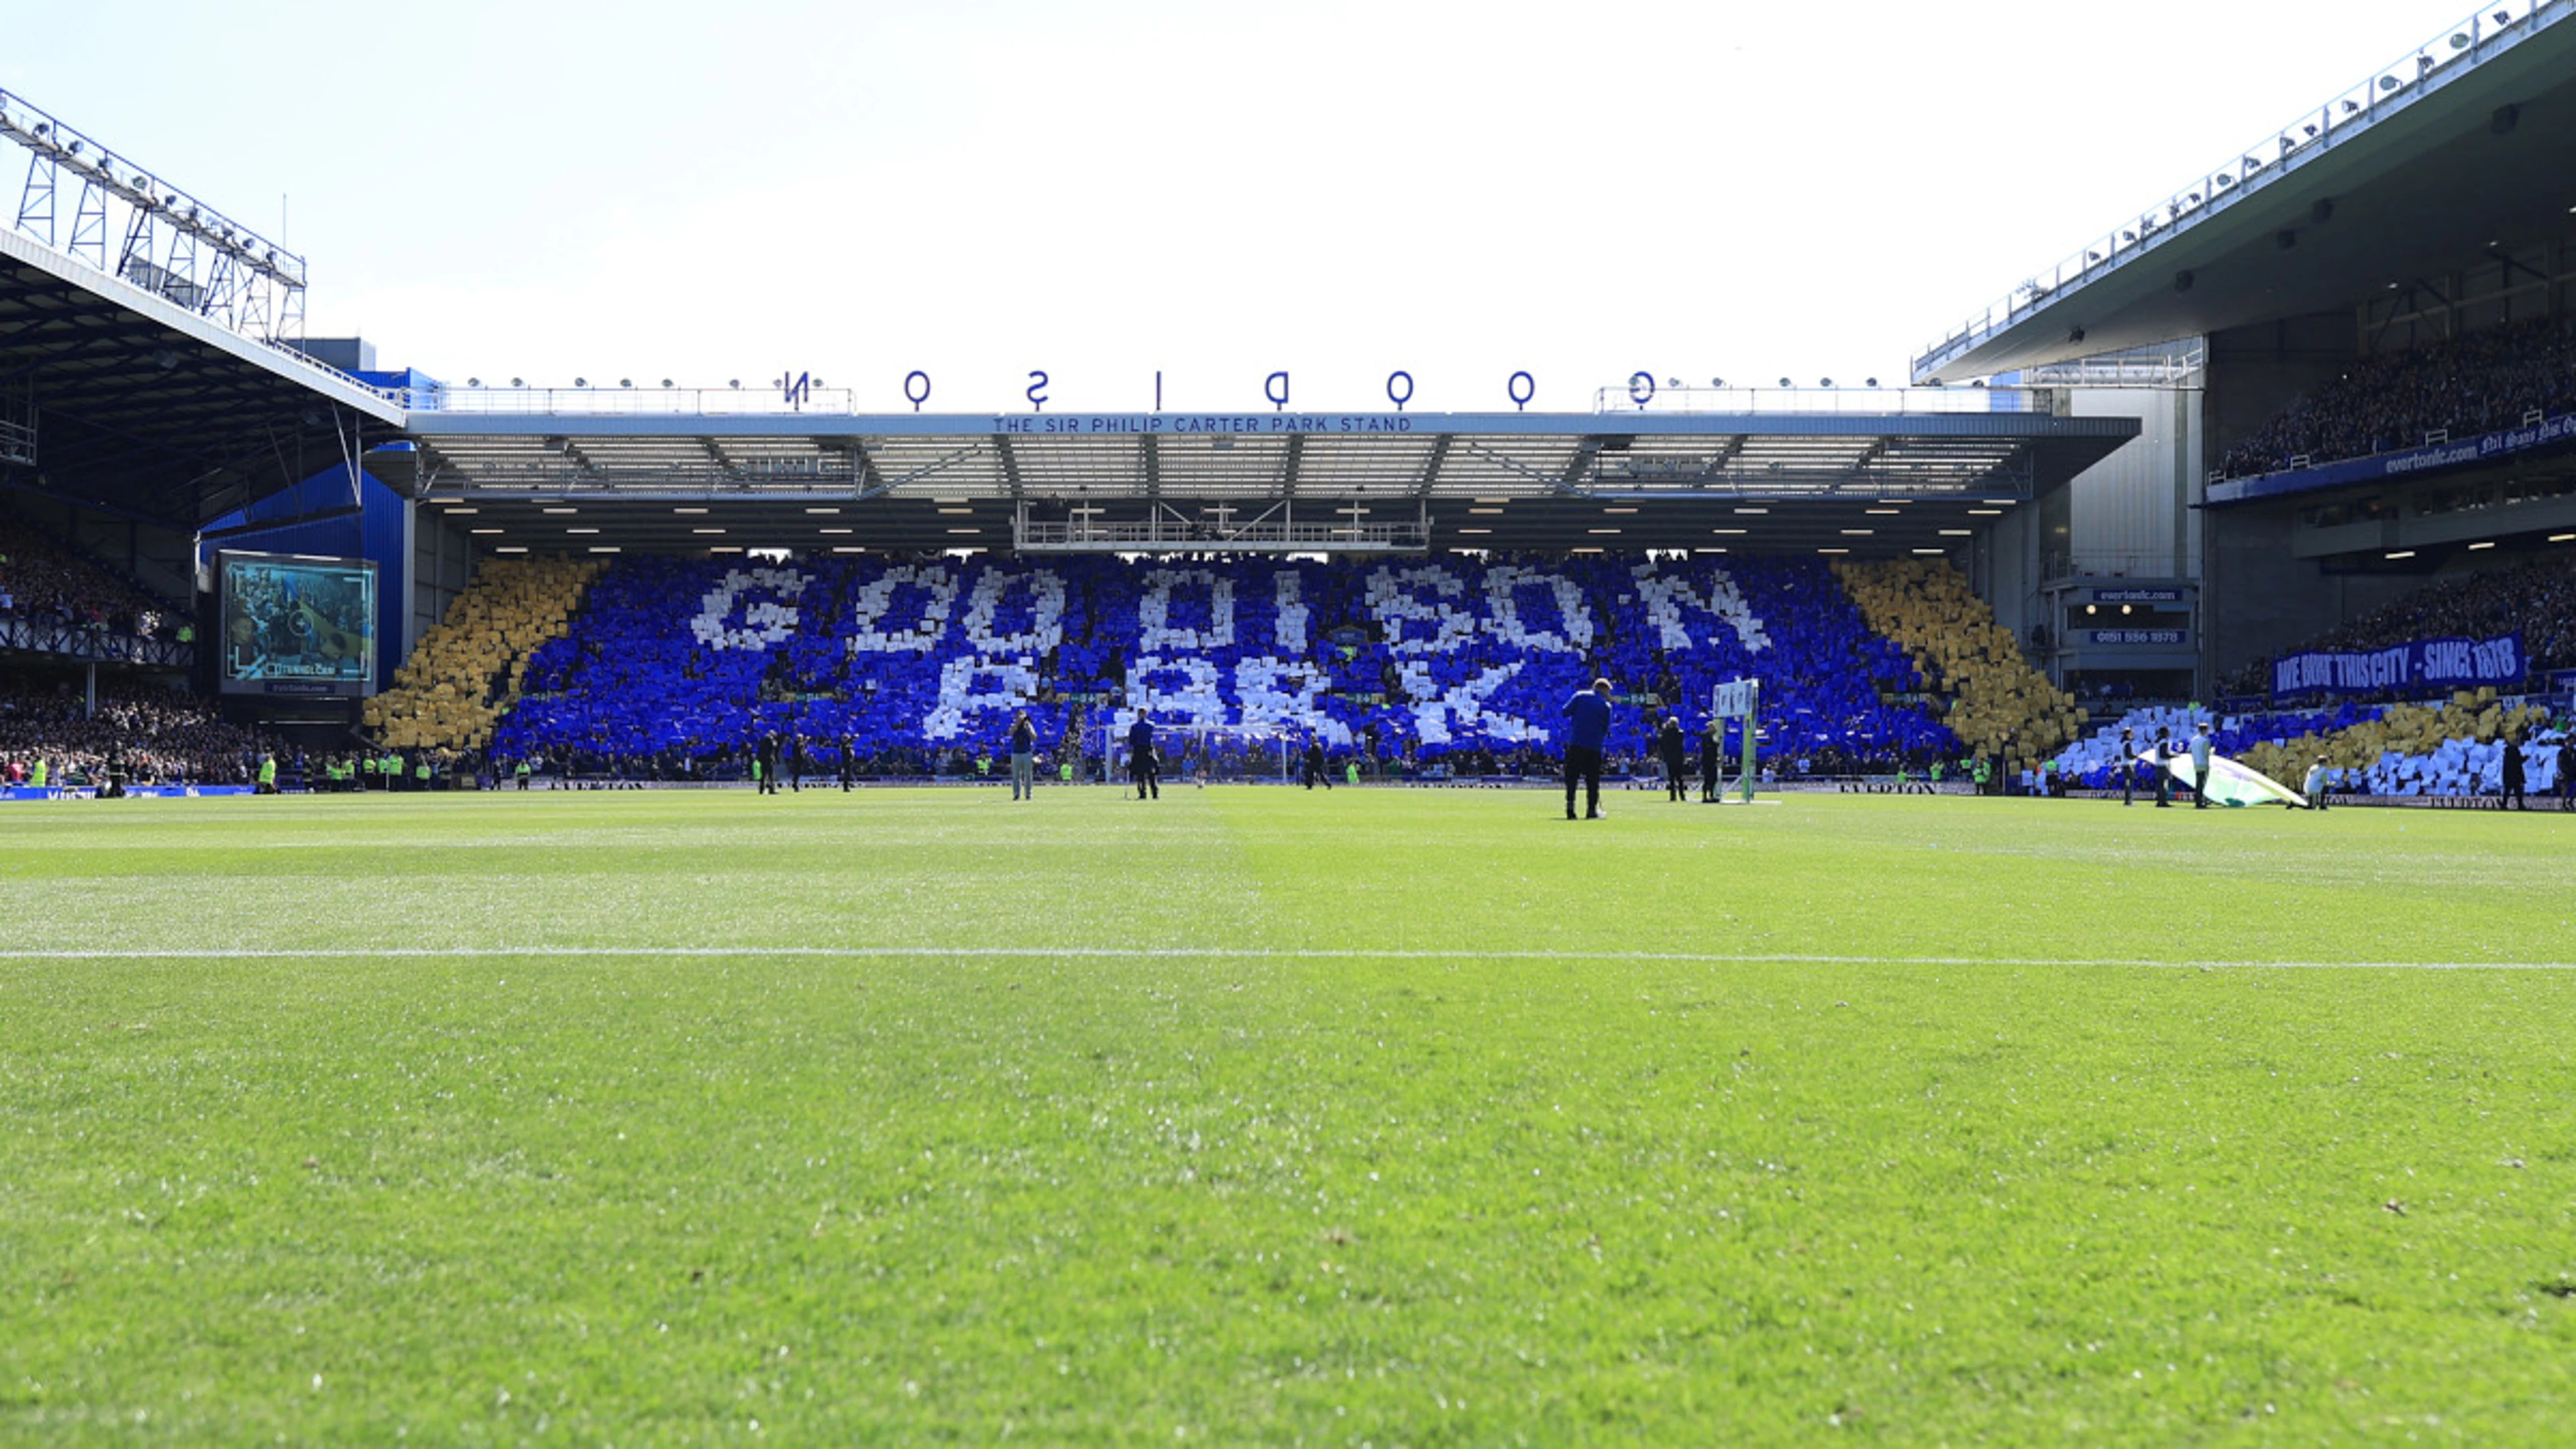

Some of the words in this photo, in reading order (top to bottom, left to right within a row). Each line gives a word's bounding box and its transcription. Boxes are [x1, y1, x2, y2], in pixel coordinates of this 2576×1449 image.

[992, 418, 1034, 433] THE
[1044, 418, 1079, 433] SIR
[1091, 418, 1163, 433] PHILIP
[1174, 417, 1259, 433] CARTER
[1272, 417, 1328, 432] PARK
[1340, 417, 1411, 432] STAND
[2277, 655, 2300, 692] WE
[2334, 653, 2369, 688] THIS
[2369, 646, 2410, 687] CITY
